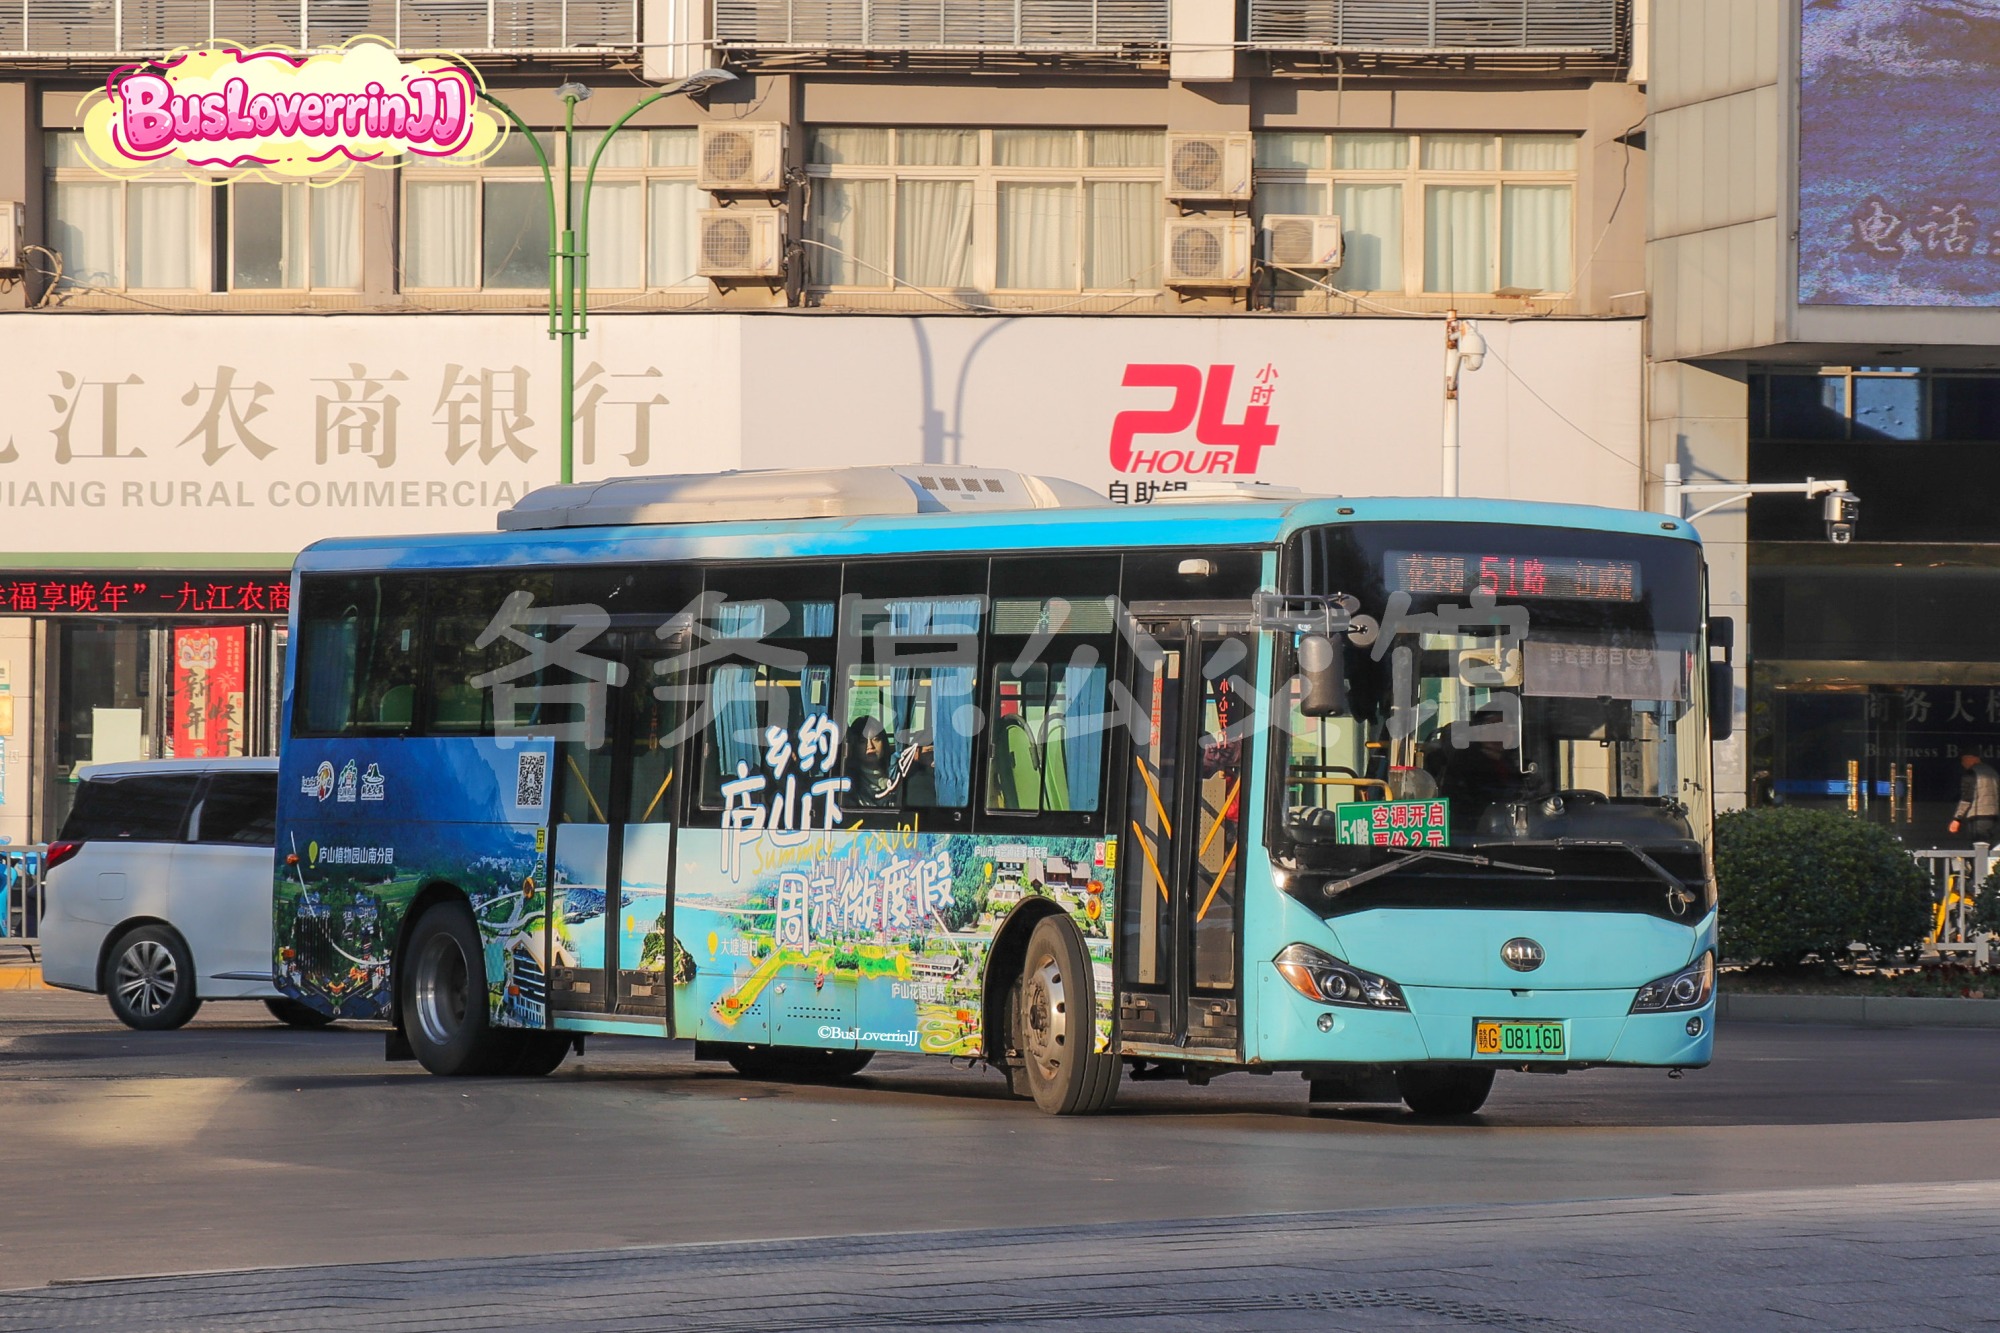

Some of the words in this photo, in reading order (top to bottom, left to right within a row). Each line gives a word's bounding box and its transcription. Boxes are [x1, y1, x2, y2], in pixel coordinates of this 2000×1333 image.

[1249, 362, 1280, 406] 小时
[0, 361, 670, 469] 江农商银行
[1109, 363, 1280, 475] 24
[1130, 449, 1236, 475] HOUR
[0, 480, 107, 507] IANG
[121, 480, 256, 507] RURAL
[1372, 803, 1445, 829] 空调开启
[318, 846, 394, 864] 庐山植物园山南分园
